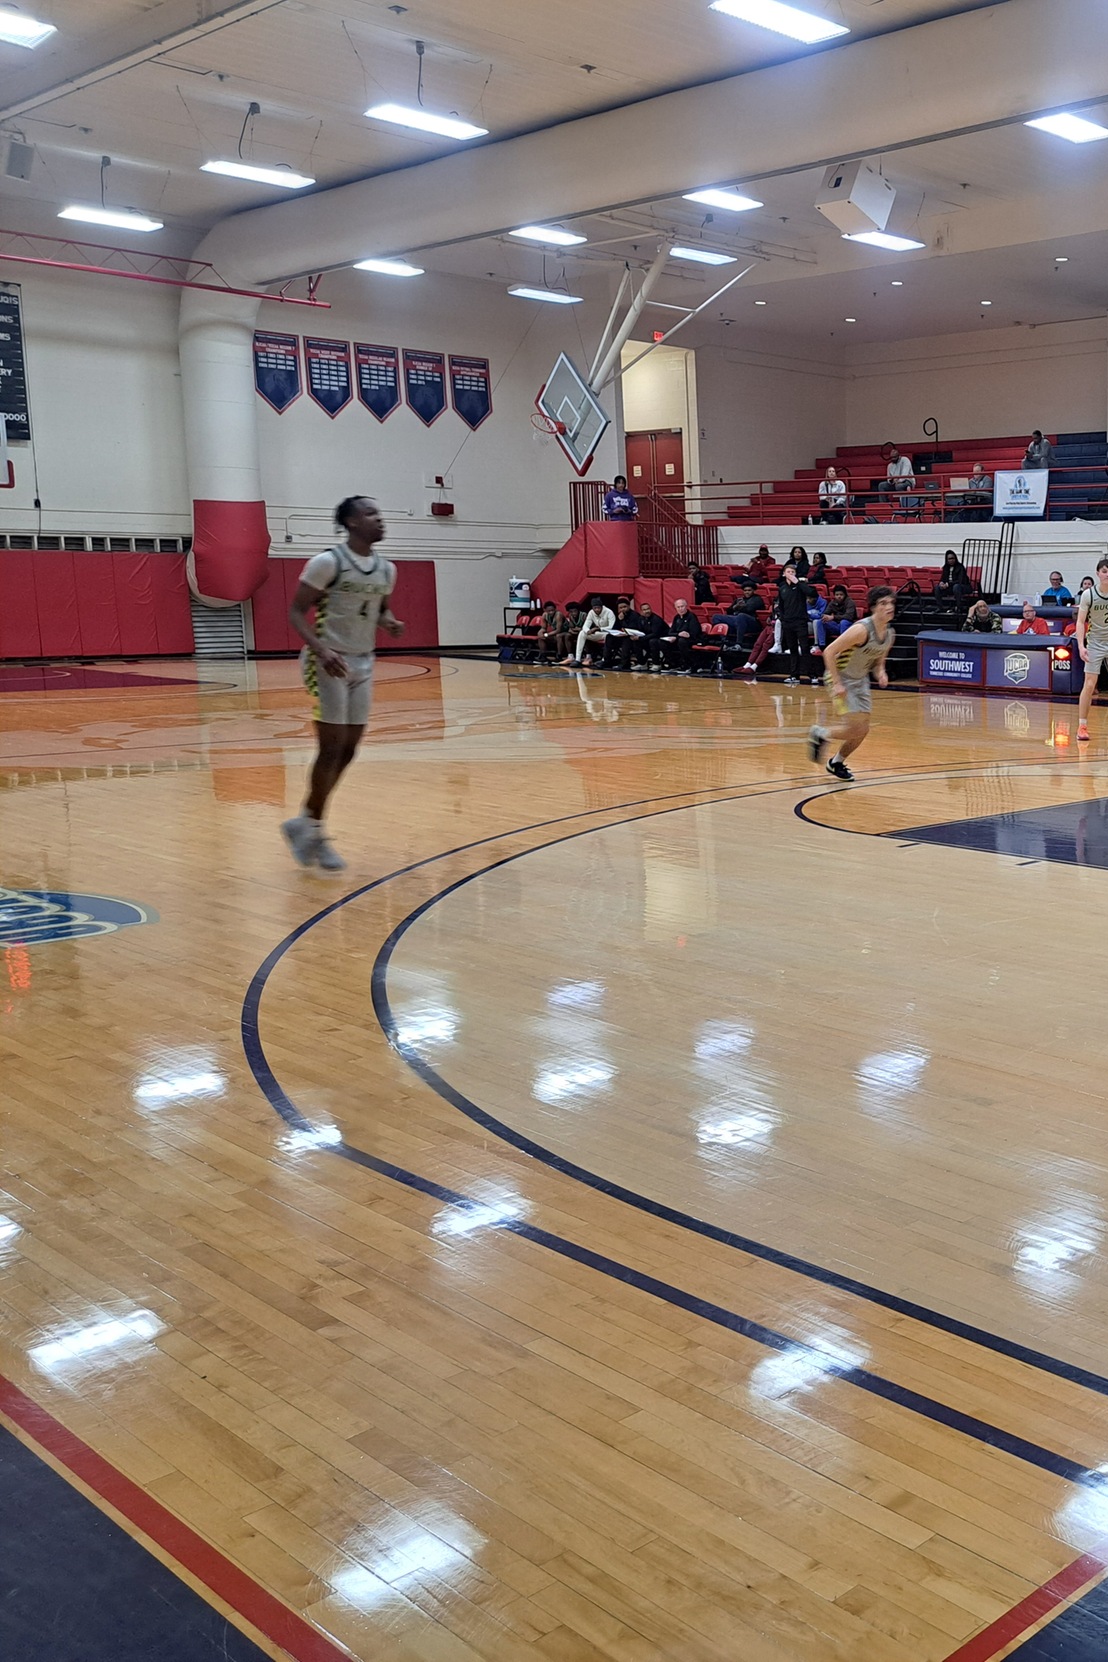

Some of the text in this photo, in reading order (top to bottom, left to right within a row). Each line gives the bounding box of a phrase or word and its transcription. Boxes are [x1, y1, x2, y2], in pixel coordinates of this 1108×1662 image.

[938, 651, 966, 660] WELCOME TO
[929, 659, 974, 673] SOUTHWEST
[1053, 660, 1071, 670] POSS
